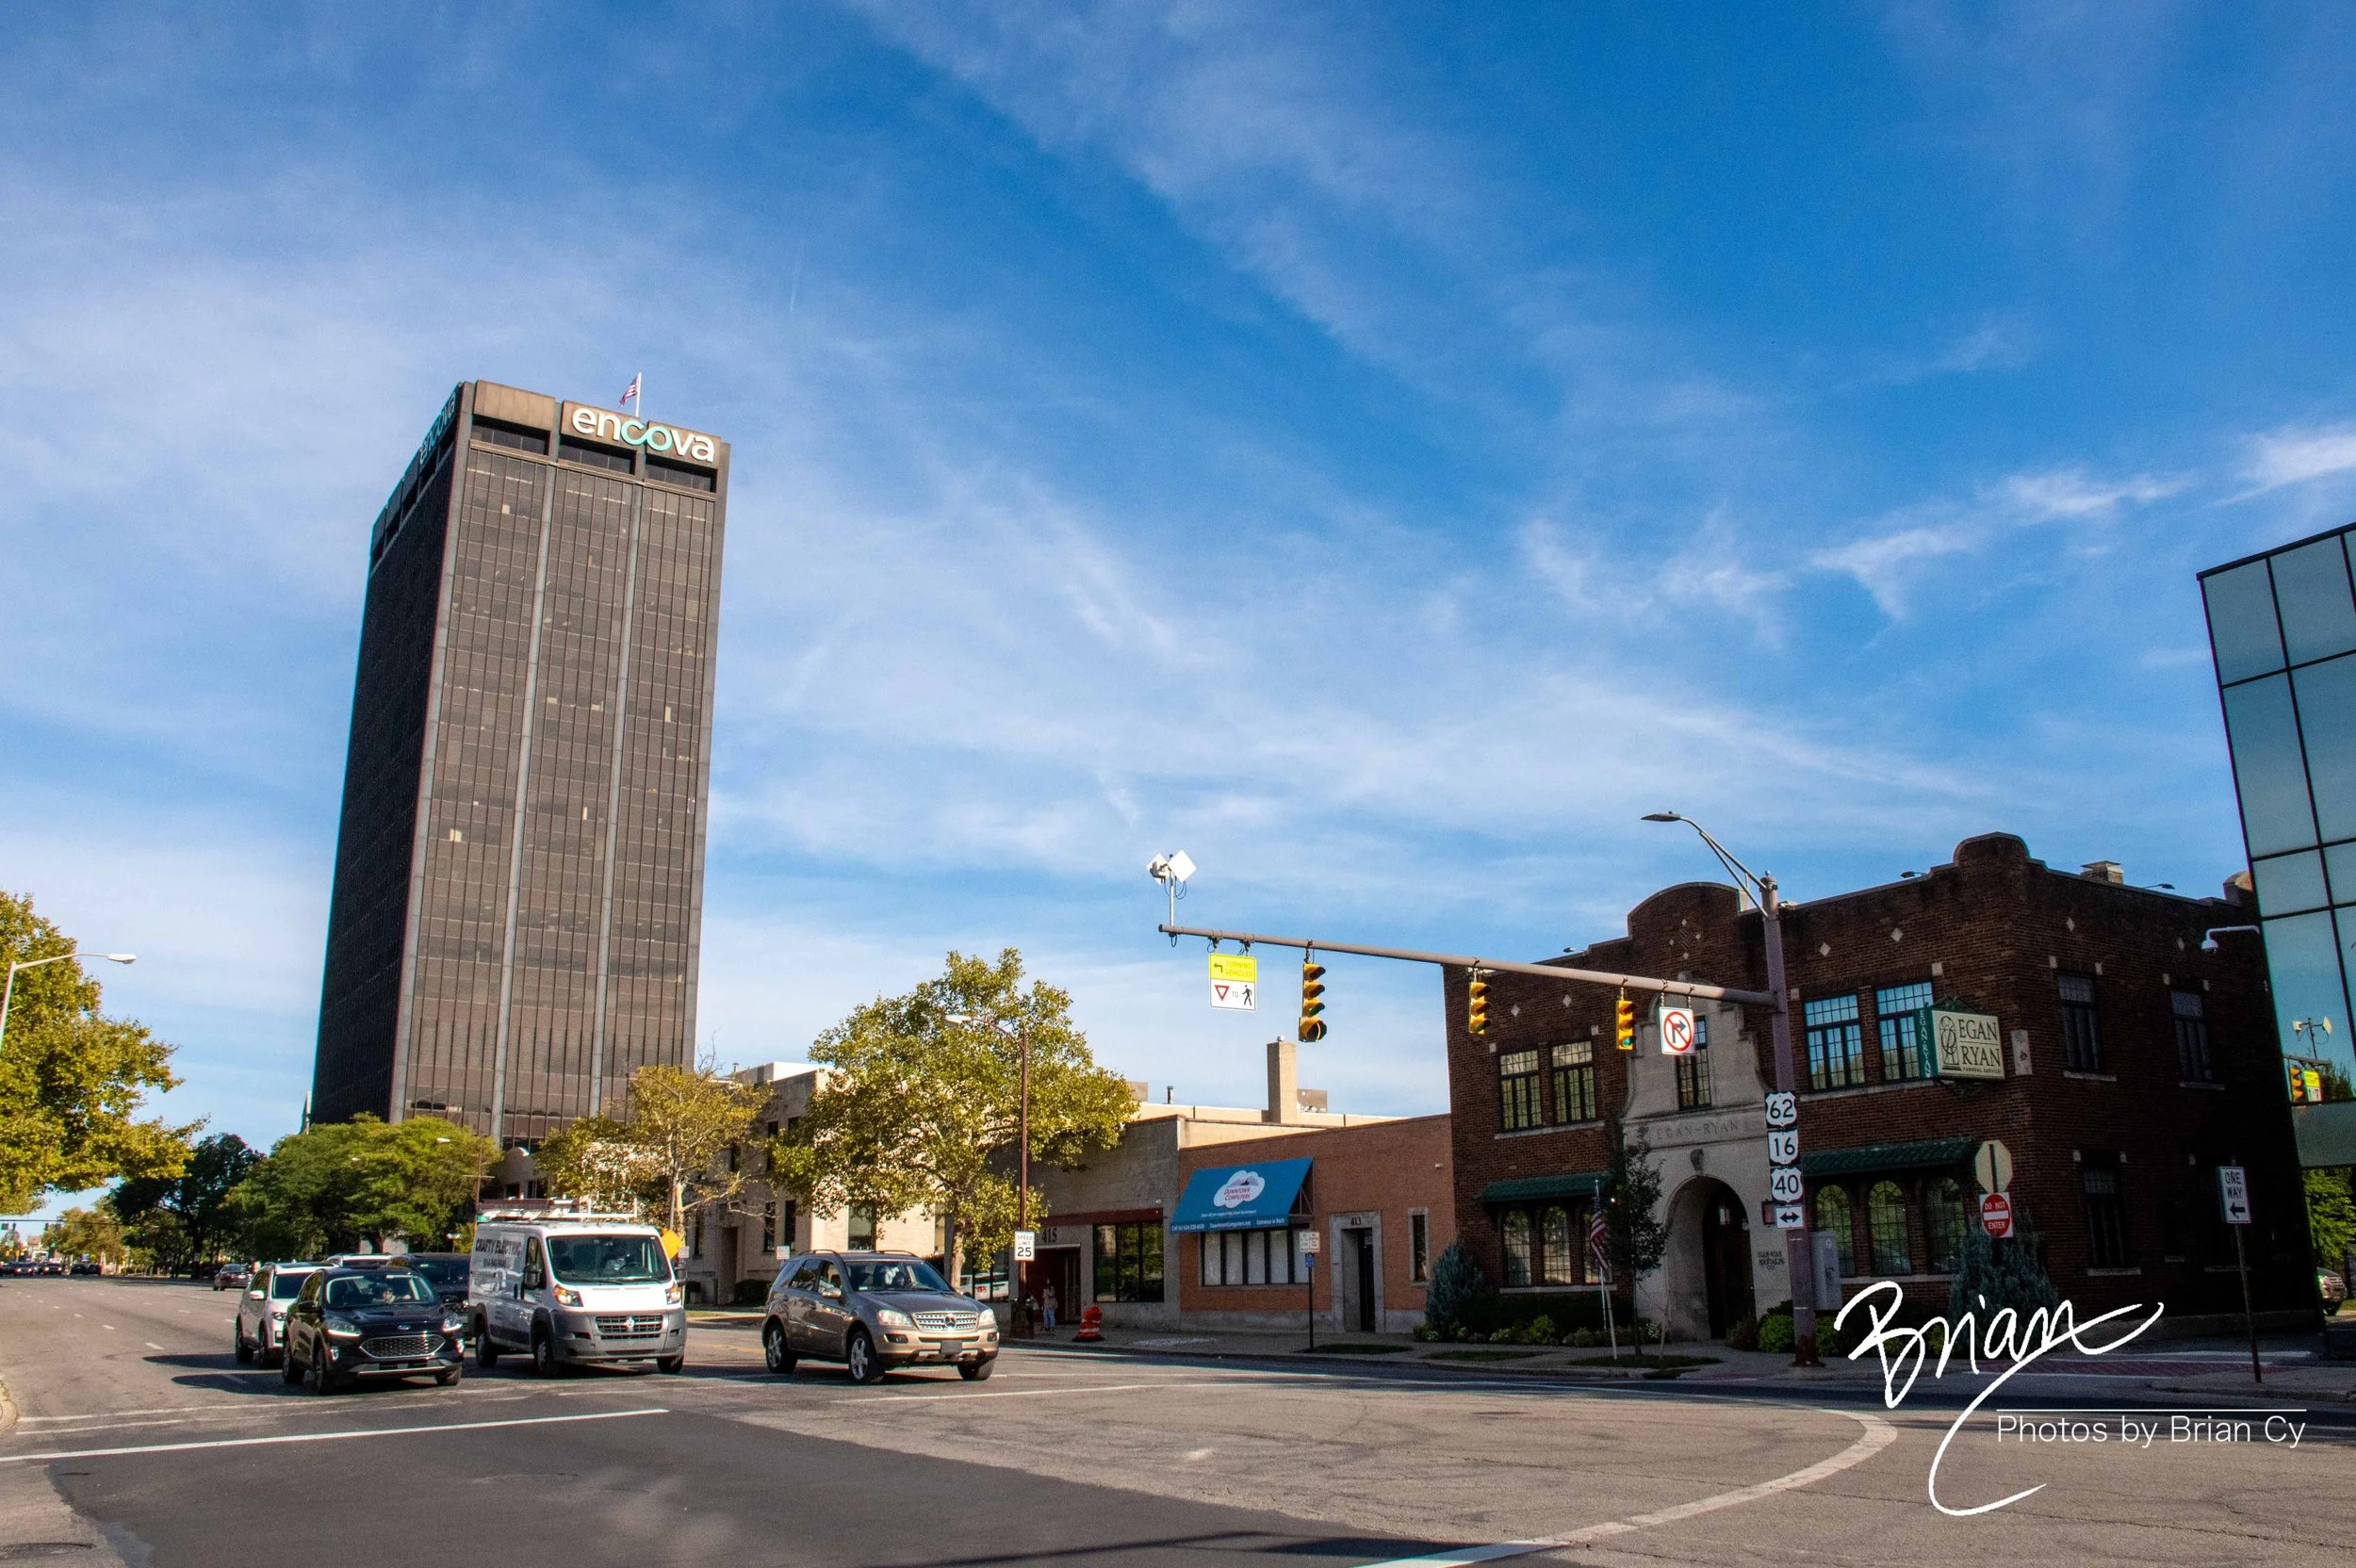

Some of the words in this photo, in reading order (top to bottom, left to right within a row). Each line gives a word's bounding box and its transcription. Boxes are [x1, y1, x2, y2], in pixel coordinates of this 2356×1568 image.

[420, 392, 457, 466] encova
[572, 408, 715, 463] encova
[1226, 961, 1252, 970] TURNING
[1232, 990, 1239, 999] TO
[1957, 1019, 1998, 1042] EGAN
[1960, 1045, 2002, 1068] RYAN
[1770, 1099, 1794, 1119] 62
[1774, 1136, 1796, 1156] 16
[1774, 1174, 1800, 1195] 40
[2225, 1171, 2242, 1184] ONE
[2227, 1186, 2243, 1199] WAY
[1984, 1202, 1993, 1211] DO
[1994, 1200, 2005, 1209] NOT
[1350, 1217, 1362, 1226] 413
[1988, 1221, 2006, 1230] ENTER
[1041, 1228, 1057, 1243] 415
[476, 1238, 497, 1252] CRAFTY
[1018, 1247, 1032, 1257] 25
